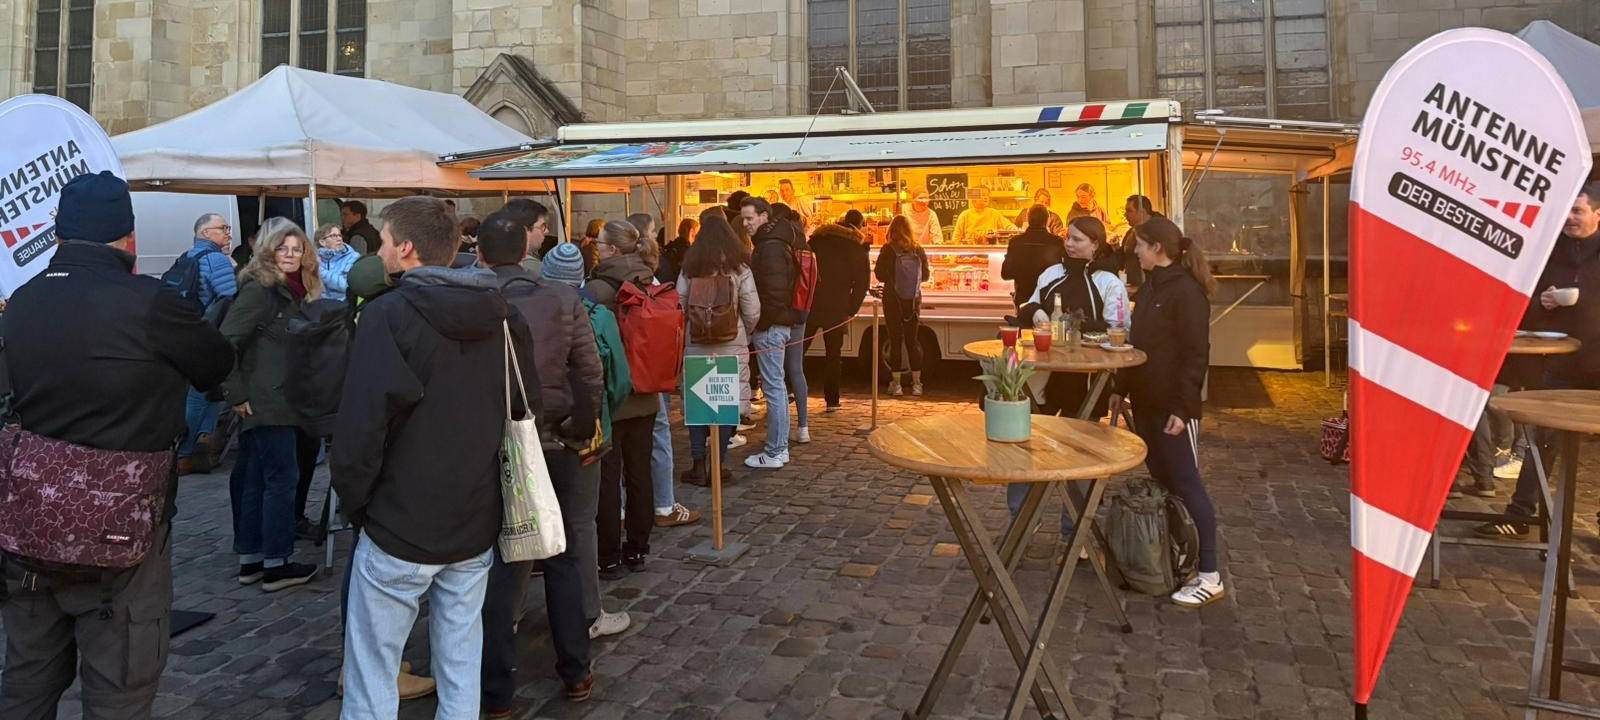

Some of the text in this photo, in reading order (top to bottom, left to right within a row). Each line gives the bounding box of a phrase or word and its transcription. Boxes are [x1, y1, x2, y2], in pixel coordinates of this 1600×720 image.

[1411, 110, 1551, 202] MÜNSTER
[1424, 82, 1565, 174] ANTENNE
[1401, 147, 1478, 195] 95.4 MHz
[1398, 179, 1516, 254] DER BESTE MIX.
[705, 384, 730, 394] LINKS
